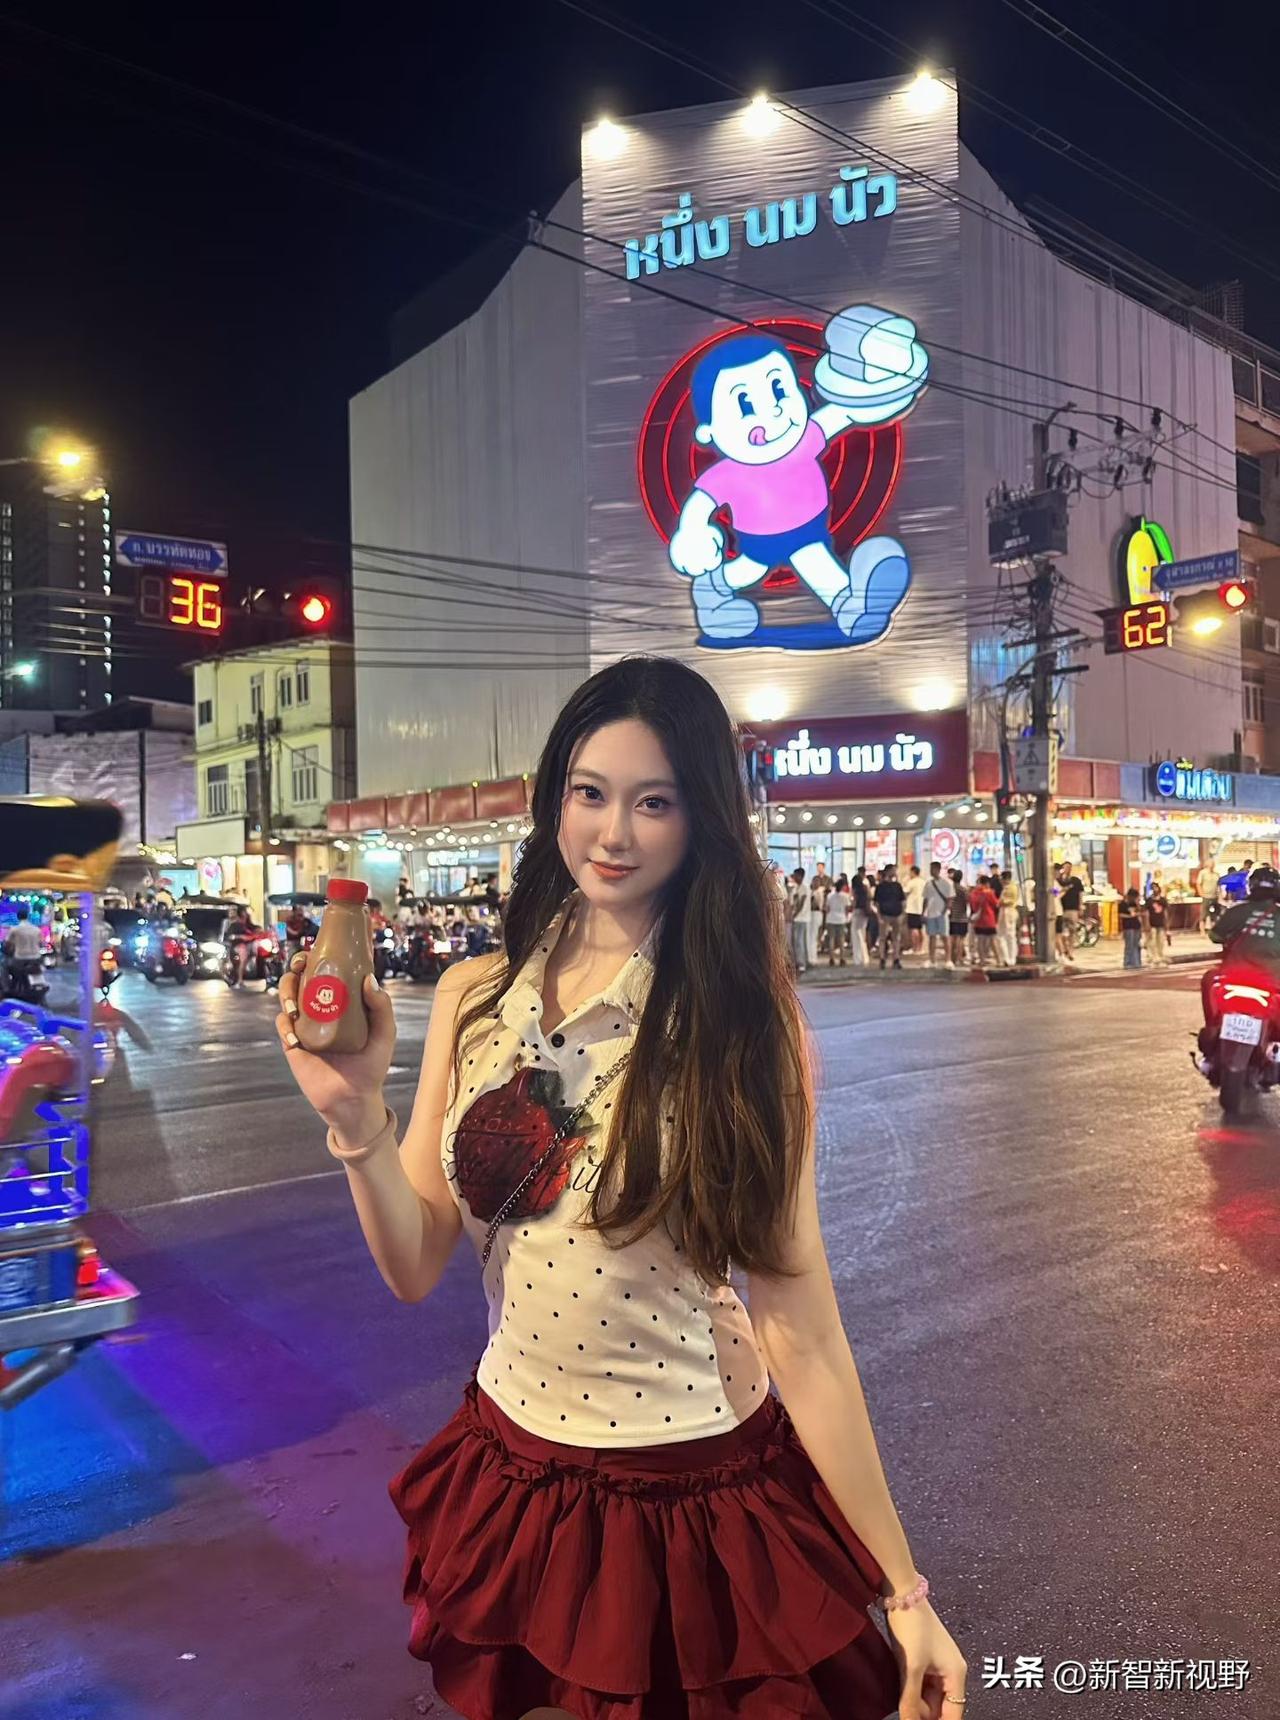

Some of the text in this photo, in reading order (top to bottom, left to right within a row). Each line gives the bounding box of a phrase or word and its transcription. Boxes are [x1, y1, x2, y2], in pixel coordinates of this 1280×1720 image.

[623, 164, 898, 280] หนึ่ง นม นัว
[171, 578, 221, 628] 36
[1124, 606, 1165, 647] 62
[837, 743, 885, 774] นม
[889, 733, 933, 772] นัว
